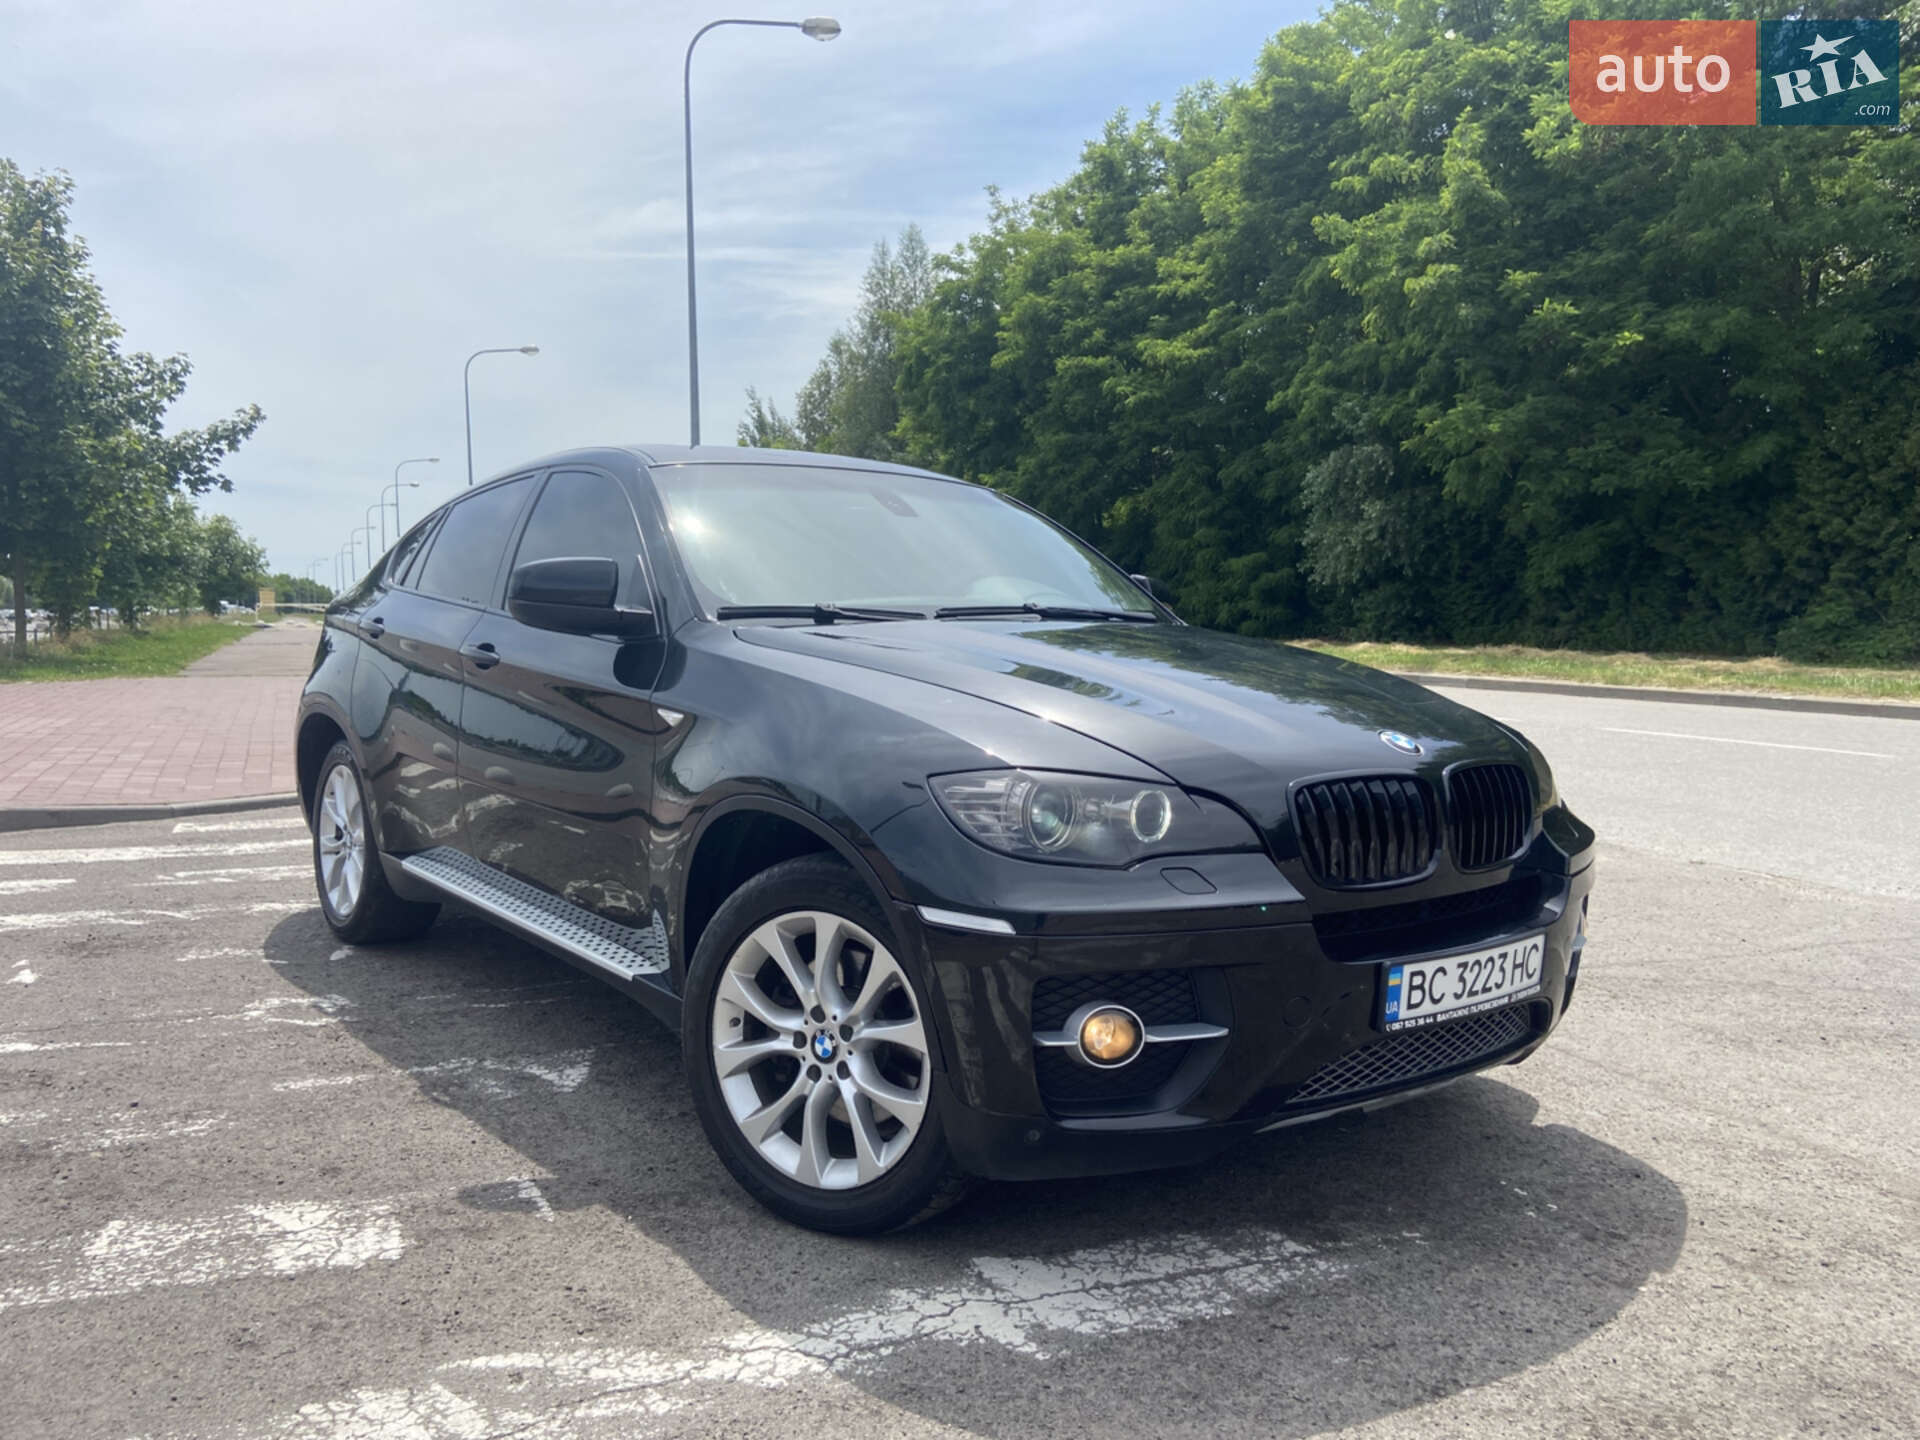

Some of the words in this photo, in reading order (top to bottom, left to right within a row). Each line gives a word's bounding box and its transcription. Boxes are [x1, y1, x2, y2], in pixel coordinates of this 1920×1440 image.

[1406, 966, 1448, 1011] BC
[1452, 952, 1509, 1000] 3223
[1510, 943, 1539, 986] HC
[1385, 1001, 1399, 1014] UA
